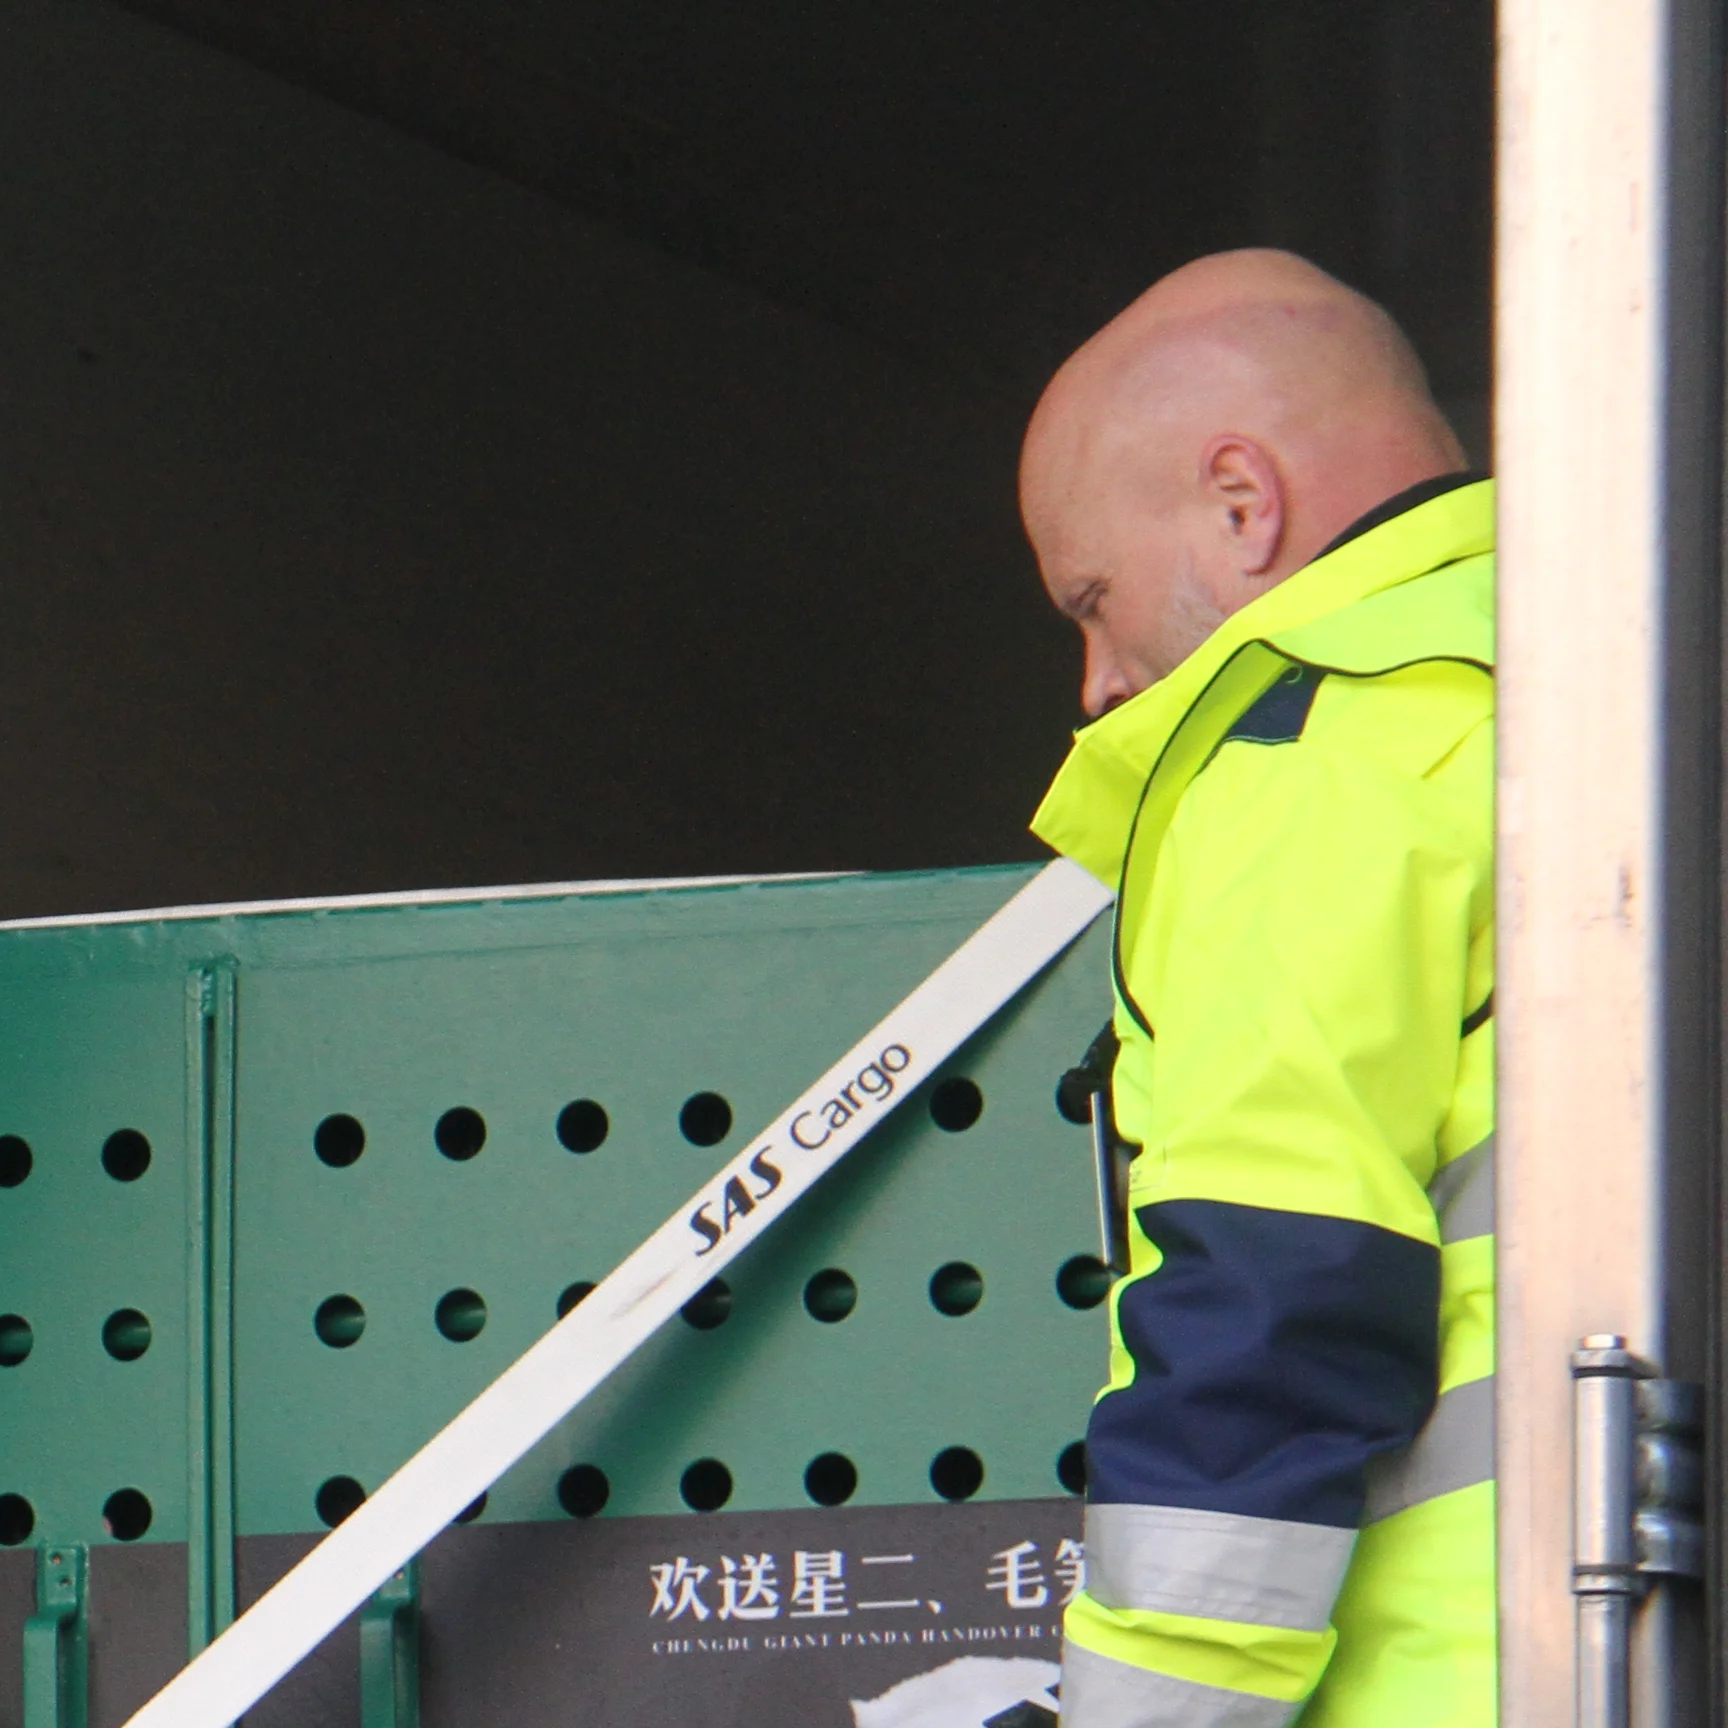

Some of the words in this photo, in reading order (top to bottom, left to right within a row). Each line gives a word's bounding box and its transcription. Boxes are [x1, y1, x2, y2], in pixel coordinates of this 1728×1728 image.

[689, 1145, 783, 1257] SAS
[789, 1043, 911, 1150] Cargo
[840, 1630, 912, 1646] PANDA
